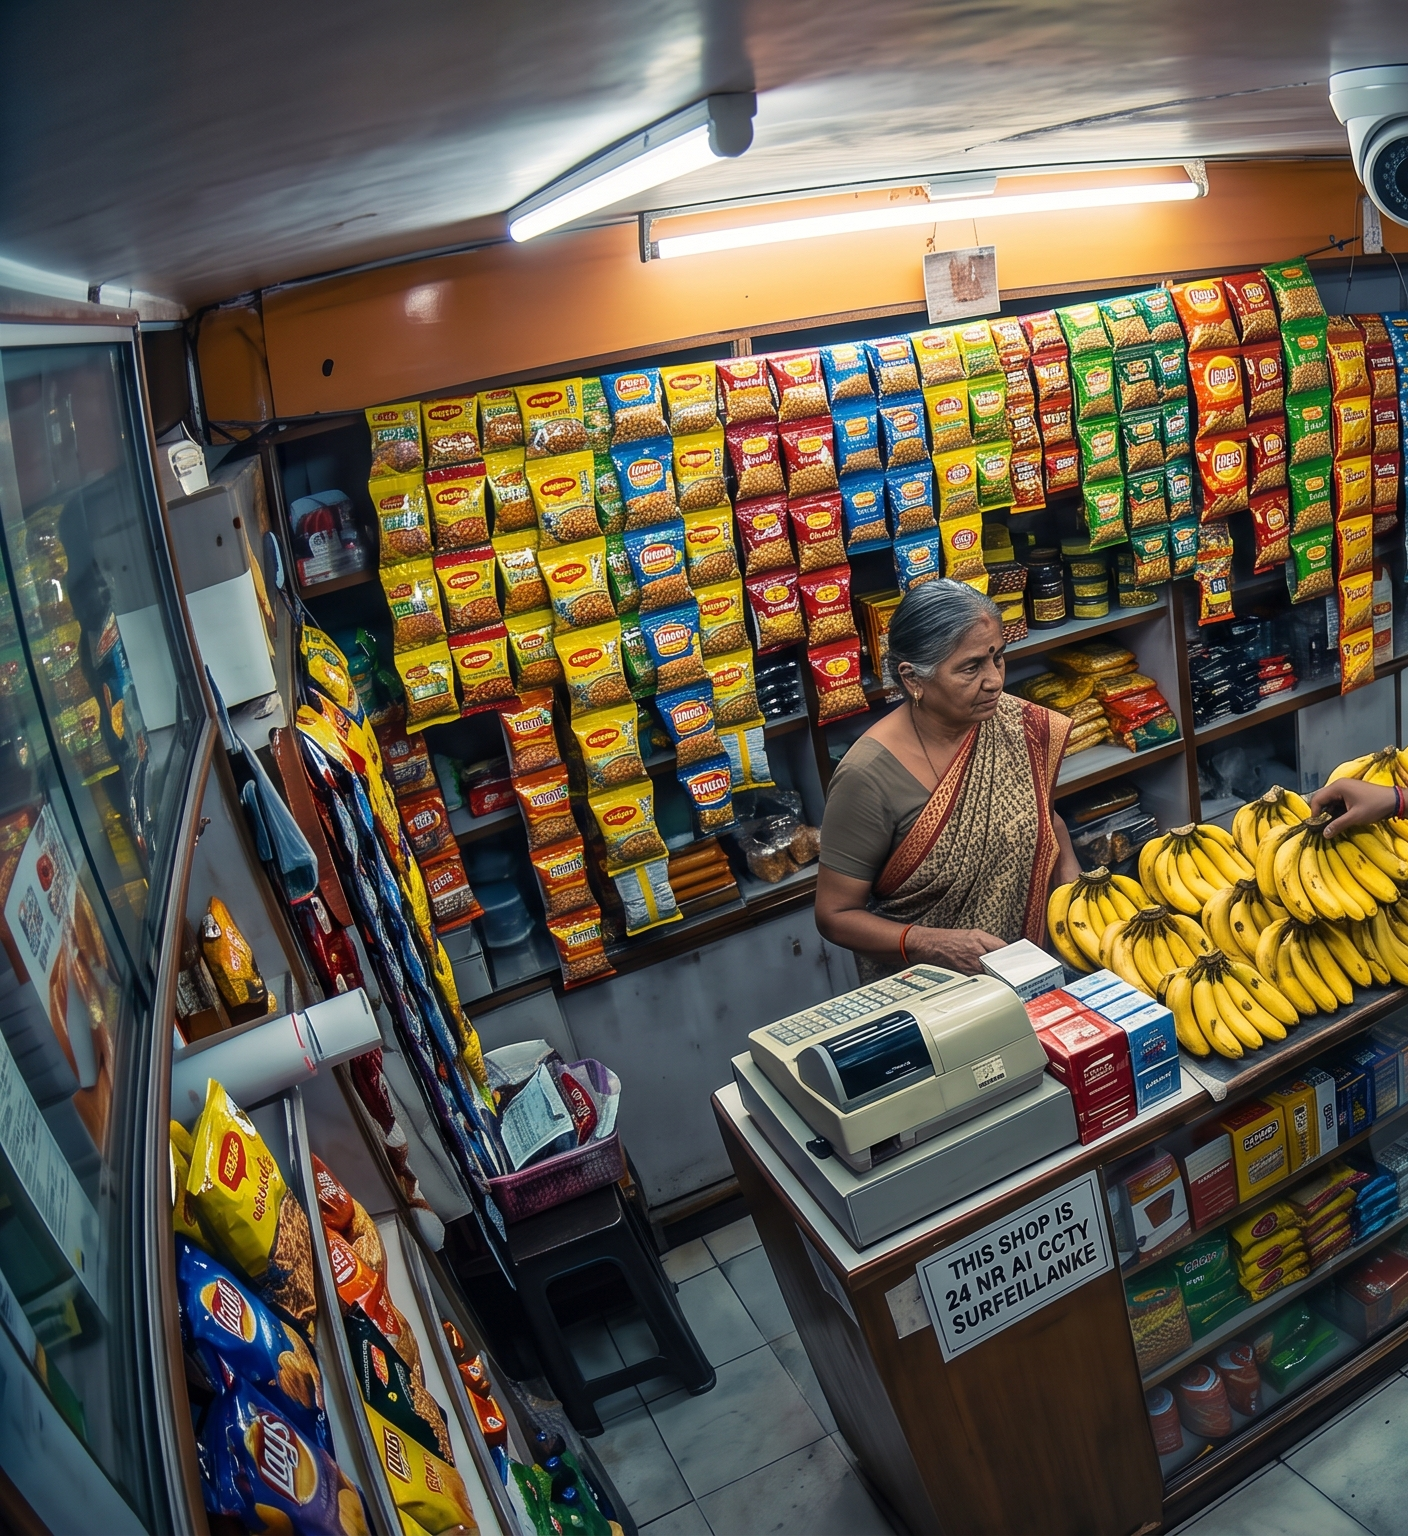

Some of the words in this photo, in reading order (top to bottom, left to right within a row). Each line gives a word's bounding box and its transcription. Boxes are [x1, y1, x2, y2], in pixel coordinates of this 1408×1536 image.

[945, 1287, 972, 1312] 24
[976, 1265, 1006, 1295] NR
[1012, 1250, 1033, 1279] AI
[1038, 1218, 1089, 1261] CCTY
[948, 1244, 995, 1280] THIS
[998, 1214, 1050, 1255] SHOP
[1055, 1201, 1074, 1225] IS
[952, 1241, 1098, 1335] SURFEILLANKE
